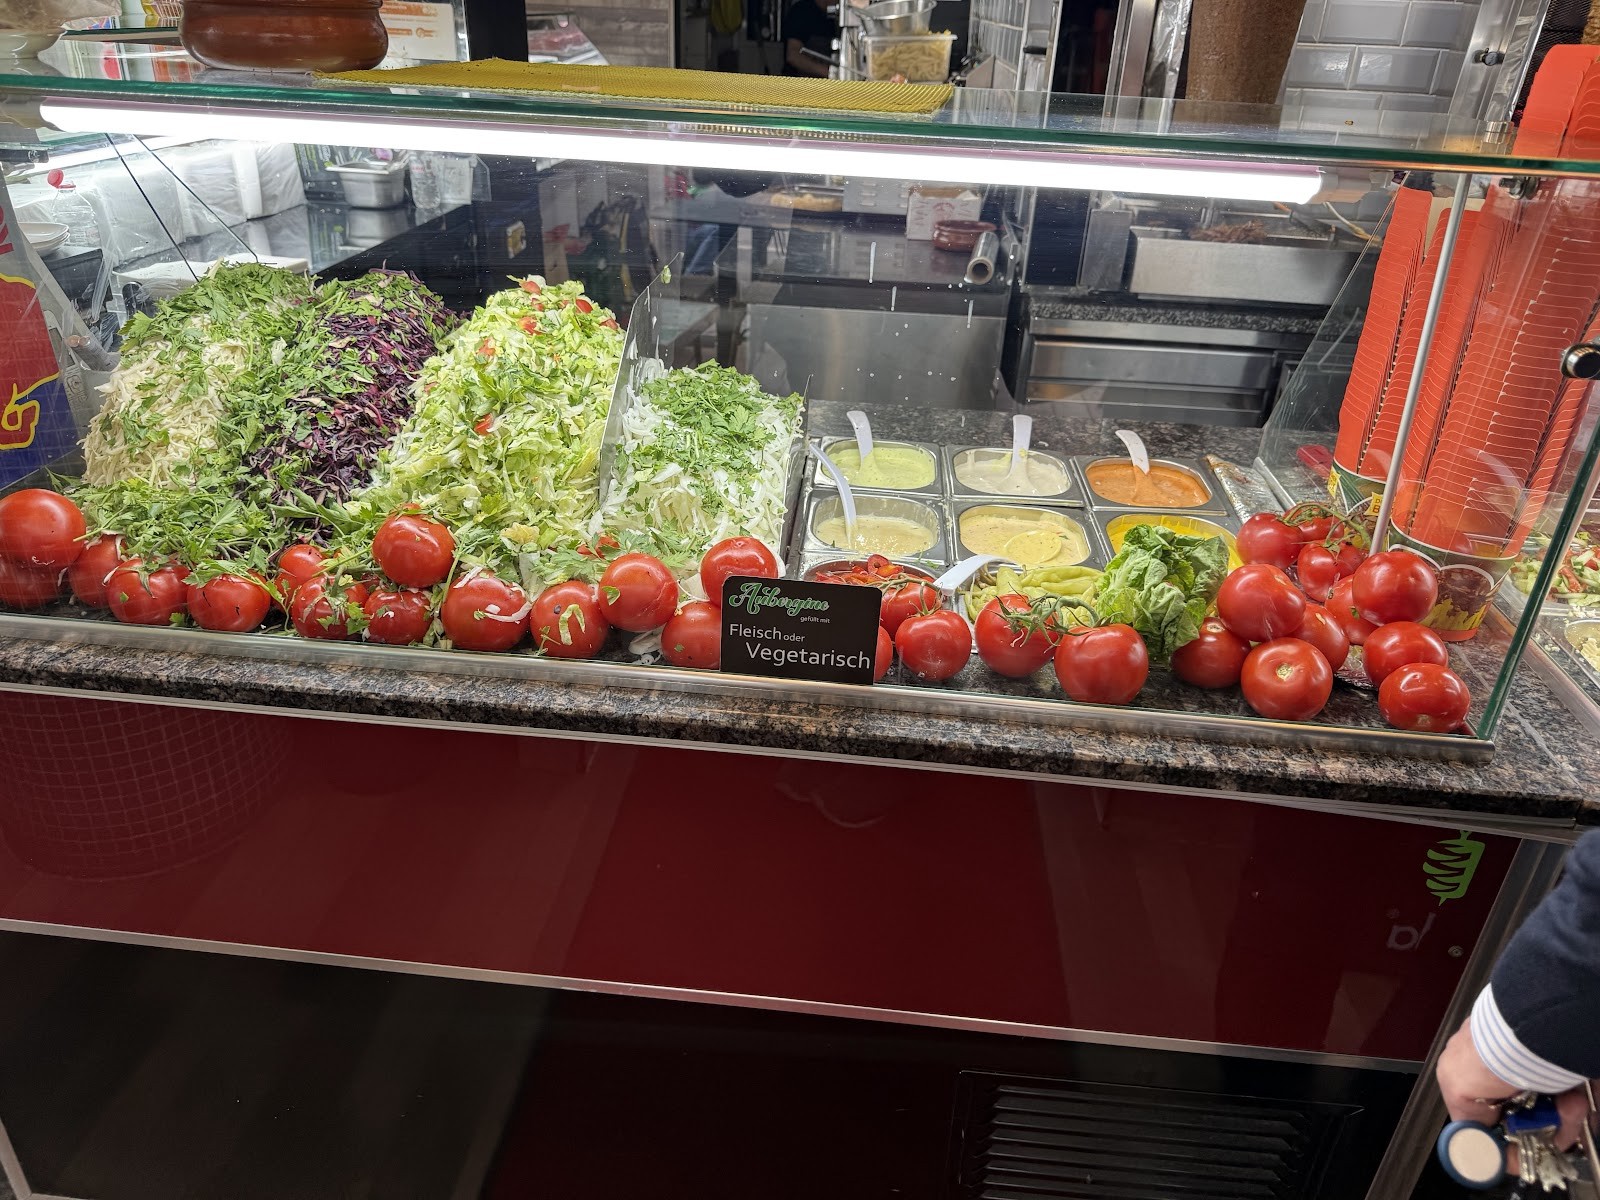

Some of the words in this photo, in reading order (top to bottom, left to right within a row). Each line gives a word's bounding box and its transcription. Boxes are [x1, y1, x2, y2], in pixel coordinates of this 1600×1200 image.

[729, 582, 830, 617] Aubergine
[800, 615, 819, 624] gefüllt
[729, 623, 782, 641] Fleisch
[783, 633, 806, 642] oder
[745, 641, 871, 669] Vegetarisch
